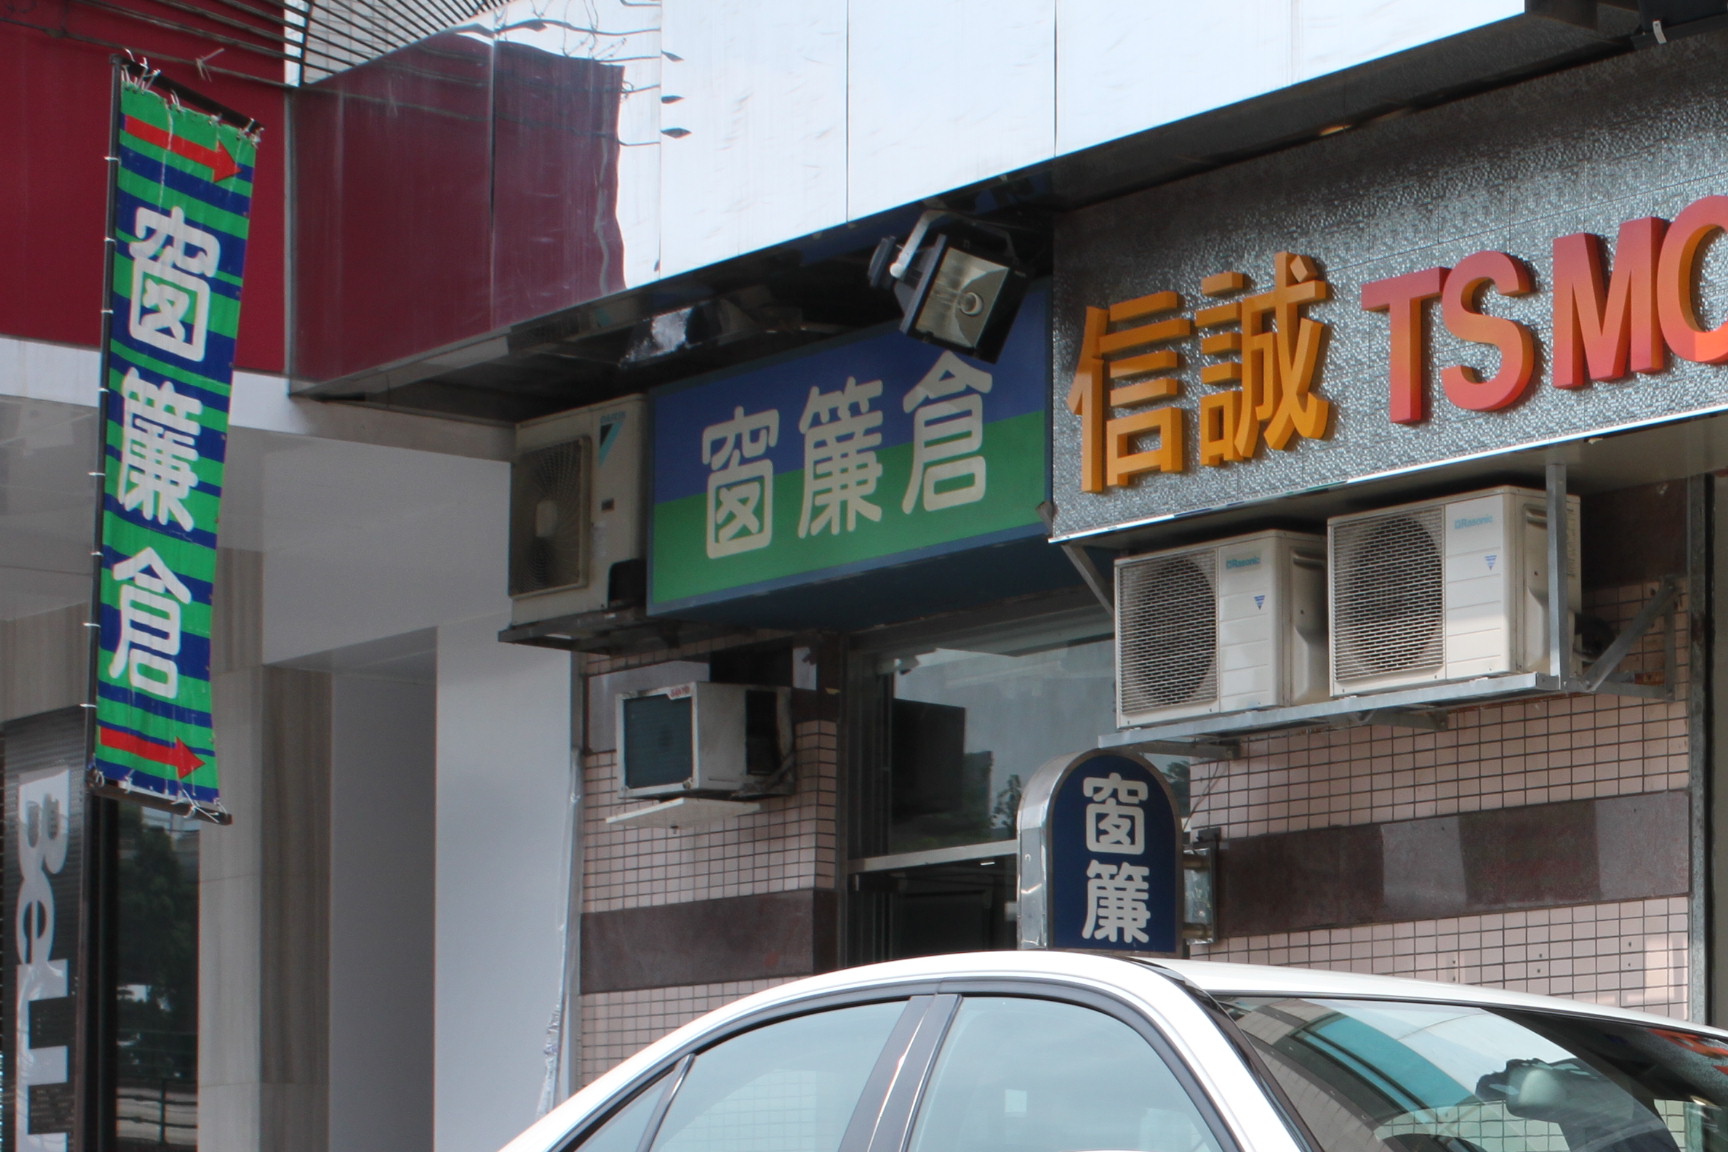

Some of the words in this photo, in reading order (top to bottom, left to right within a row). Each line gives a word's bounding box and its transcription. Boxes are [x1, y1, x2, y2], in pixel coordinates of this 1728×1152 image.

[701, 350, 993, 560] 窗簾倉
[1066, 251, 1331, 493] 信誠
[1082, 773, 1151, 945] 窗簾
